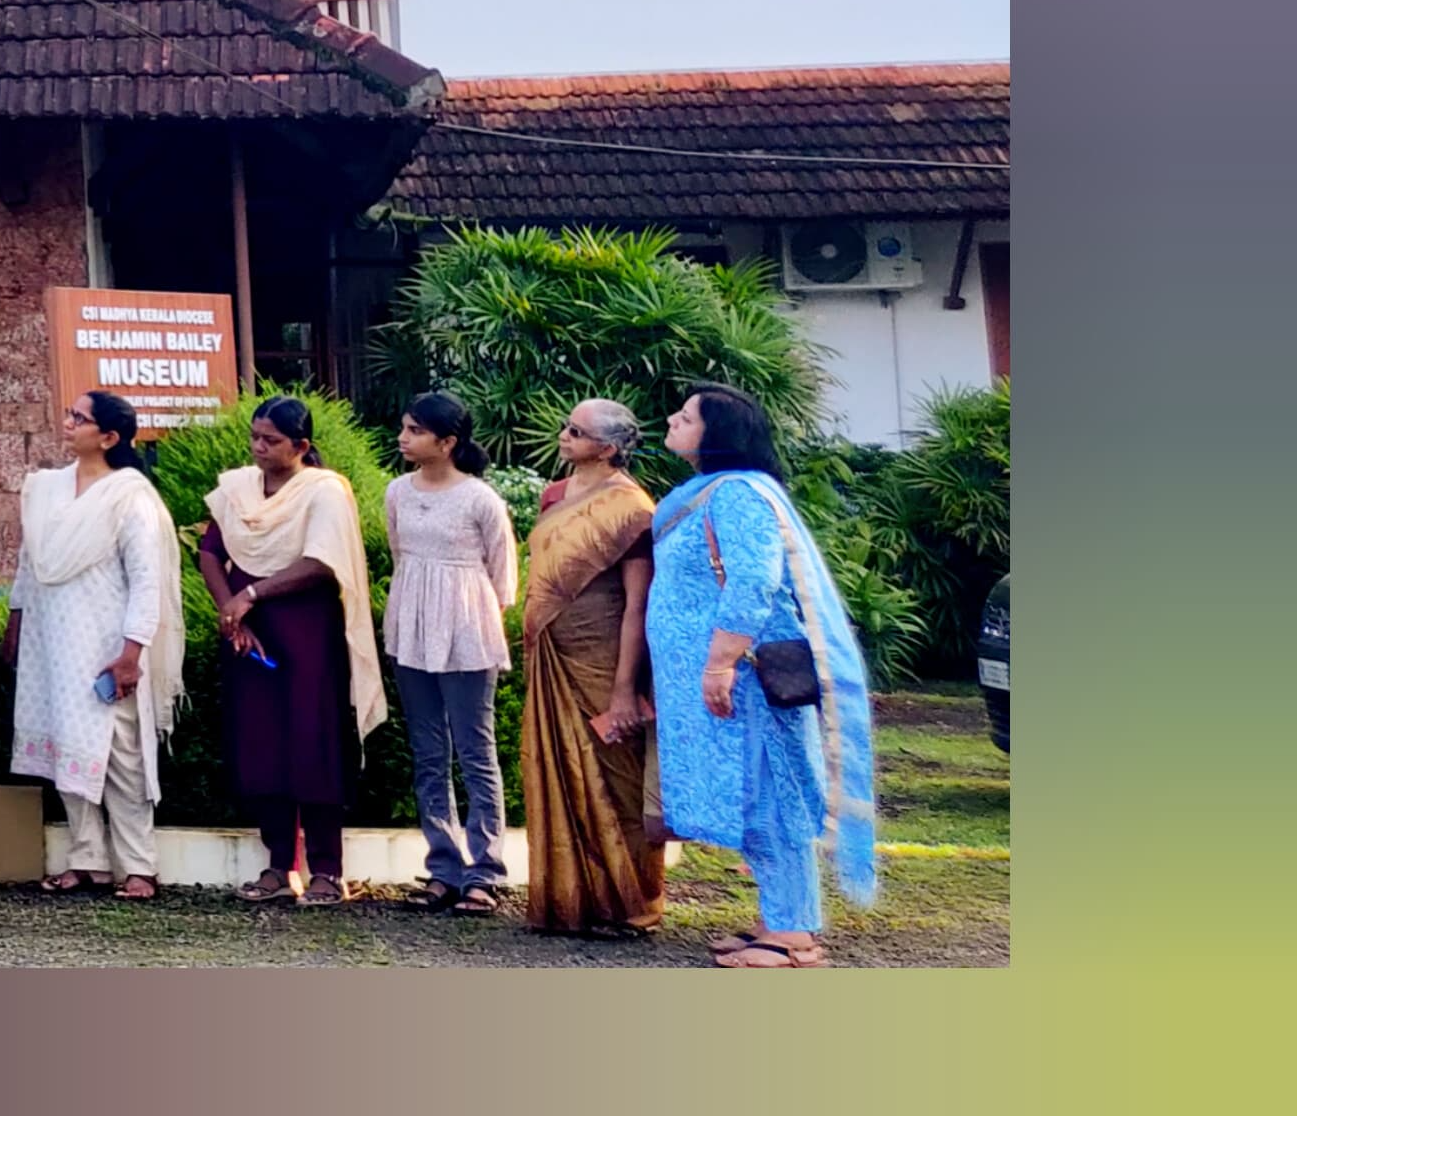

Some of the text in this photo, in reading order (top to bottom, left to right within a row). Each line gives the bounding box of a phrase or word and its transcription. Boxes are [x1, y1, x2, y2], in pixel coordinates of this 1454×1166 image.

[82, 307, 98, 320] CSI
[139, 309, 176, 322] KERALA
[176, 310, 214, 324] DIOCESE
[77, 330, 222, 352] BENJAMIN BAILEY
[99, 358, 209, 386] MUSEUM
